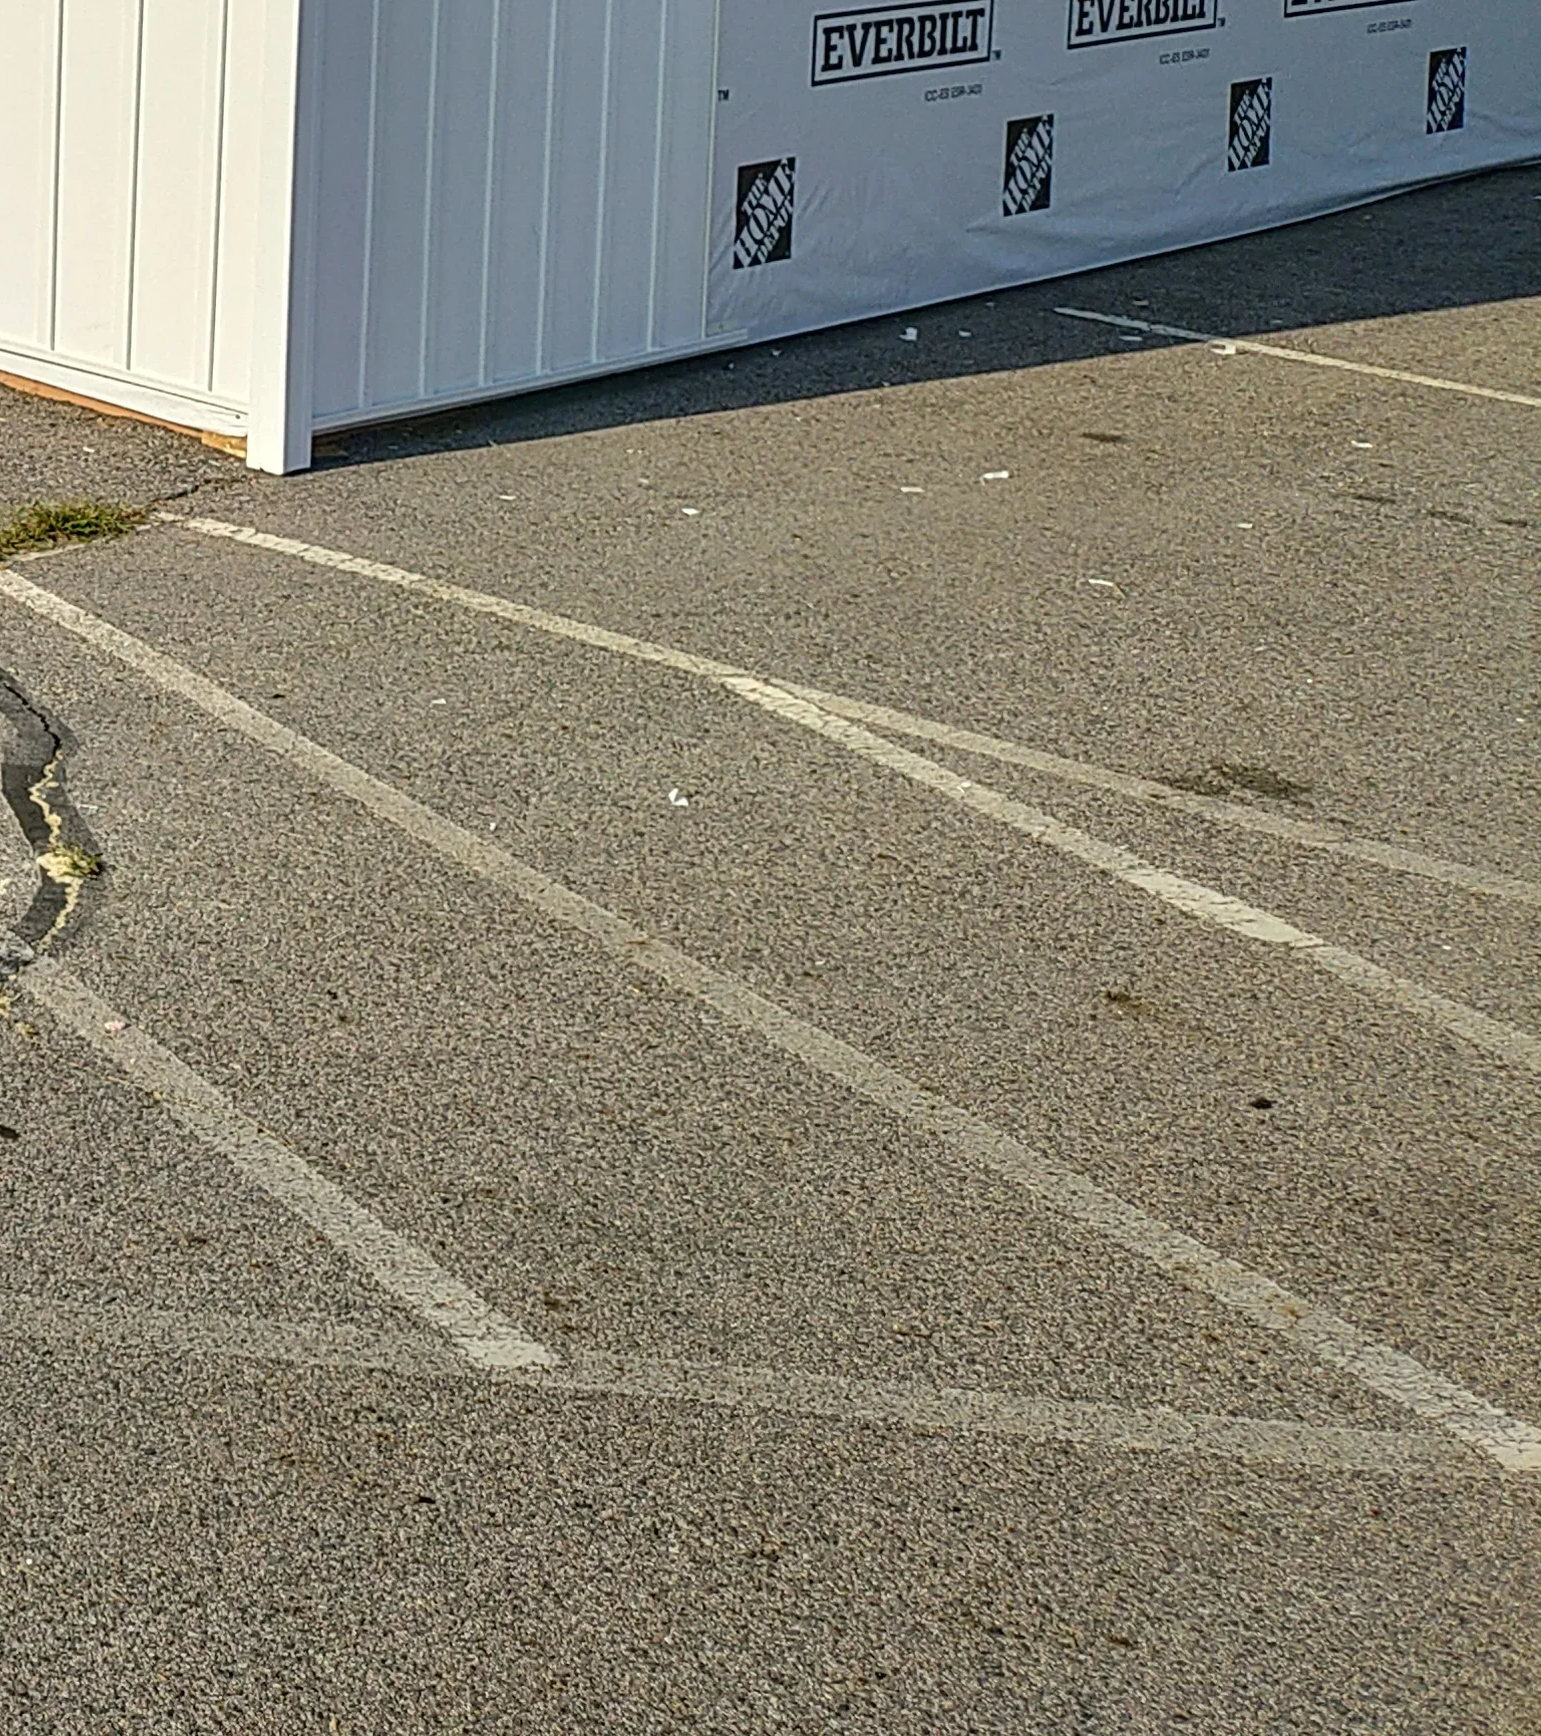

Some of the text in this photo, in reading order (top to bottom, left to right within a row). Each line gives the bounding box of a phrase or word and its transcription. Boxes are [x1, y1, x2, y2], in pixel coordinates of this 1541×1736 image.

[821, 8, 985, 72] EVERBILT
[741, 172, 767, 217] THE
[1003, 115, 1053, 214] HOME
[733, 158, 795, 267] HOME
